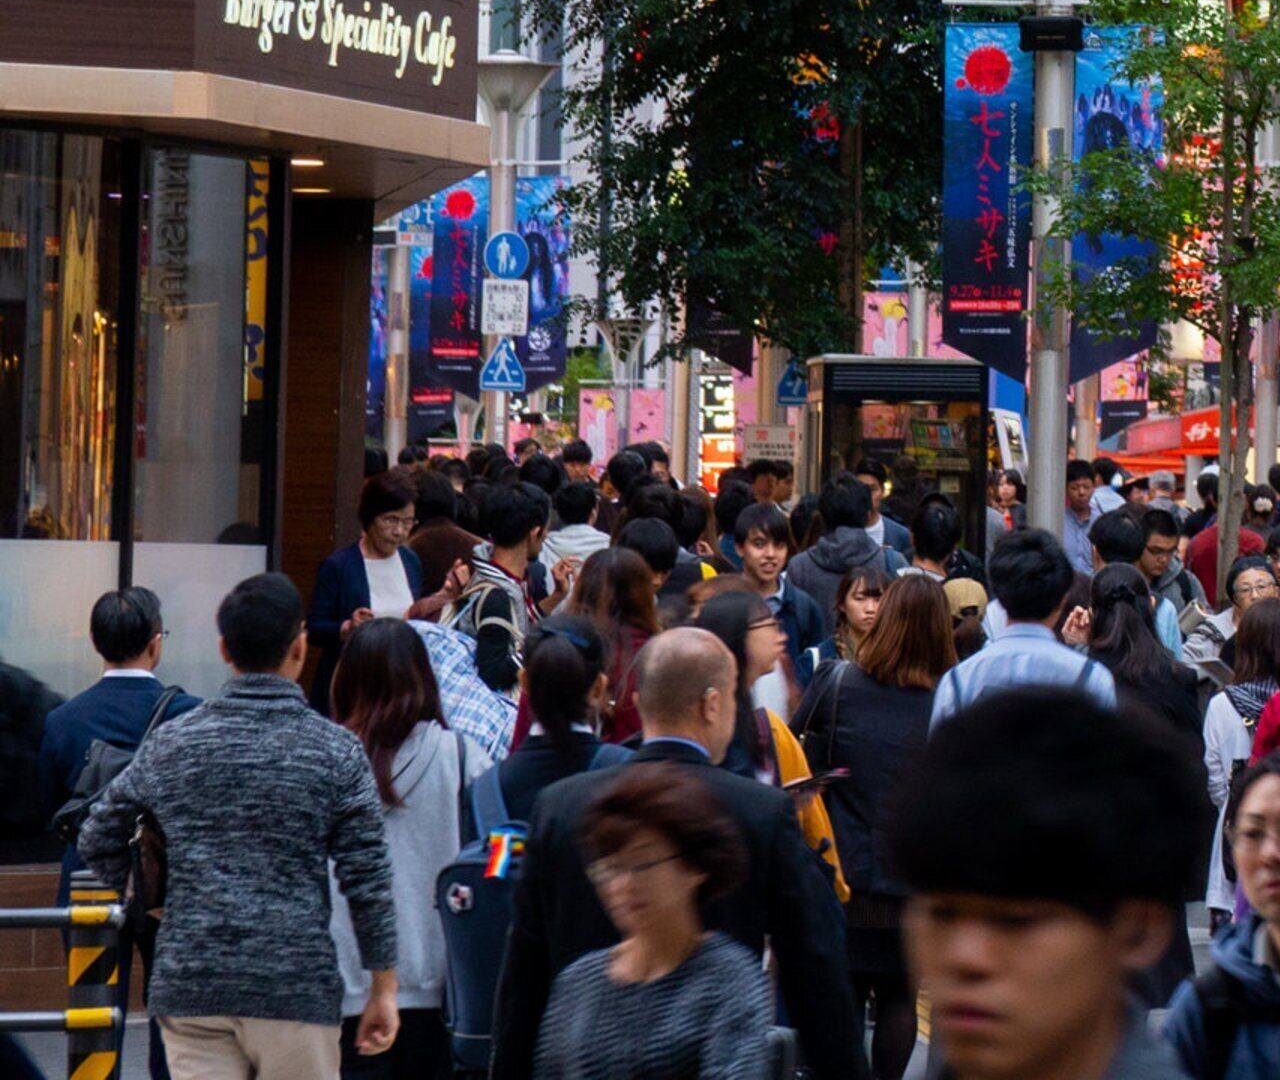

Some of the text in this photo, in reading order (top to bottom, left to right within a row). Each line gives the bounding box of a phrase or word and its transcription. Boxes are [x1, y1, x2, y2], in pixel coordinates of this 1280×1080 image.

[414, 12, 457, 77] Cafe
[970, 103, 1007, 273] 七人ミサキ
